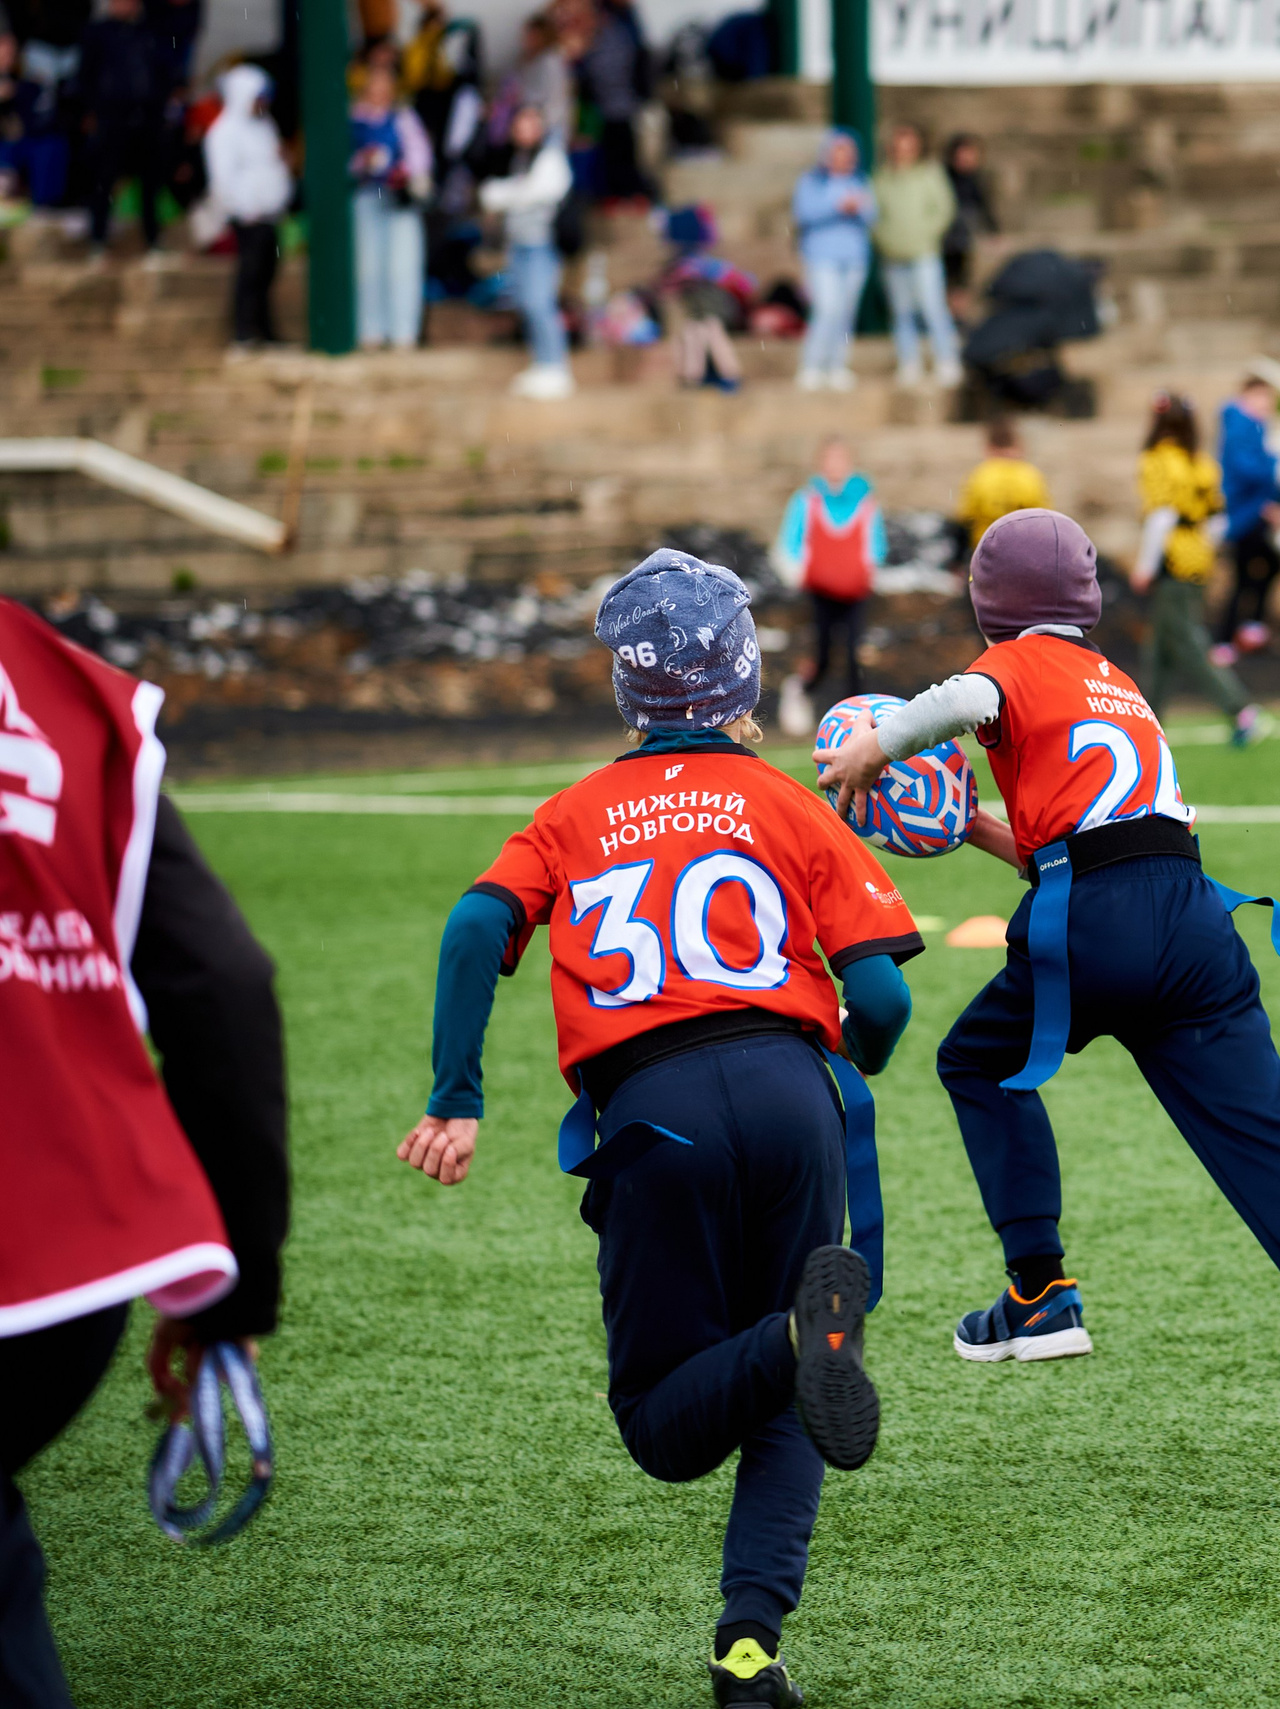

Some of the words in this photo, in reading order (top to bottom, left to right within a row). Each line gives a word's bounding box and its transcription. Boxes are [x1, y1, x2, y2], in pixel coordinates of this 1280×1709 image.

[618, 641, 657, 668] 96
[734, 636, 757, 679] 96
[1083, 679, 1151, 712] НИЖНИ
[1086, 697, 1166, 736] НОВГОР
[605, 791, 747, 826] НИЖНИЙ
[599, 812, 755, 857] НОВГОРОД
[1040, 856, 1068, 872] OFFLOAD
[569, 849, 790, 1010] 30
